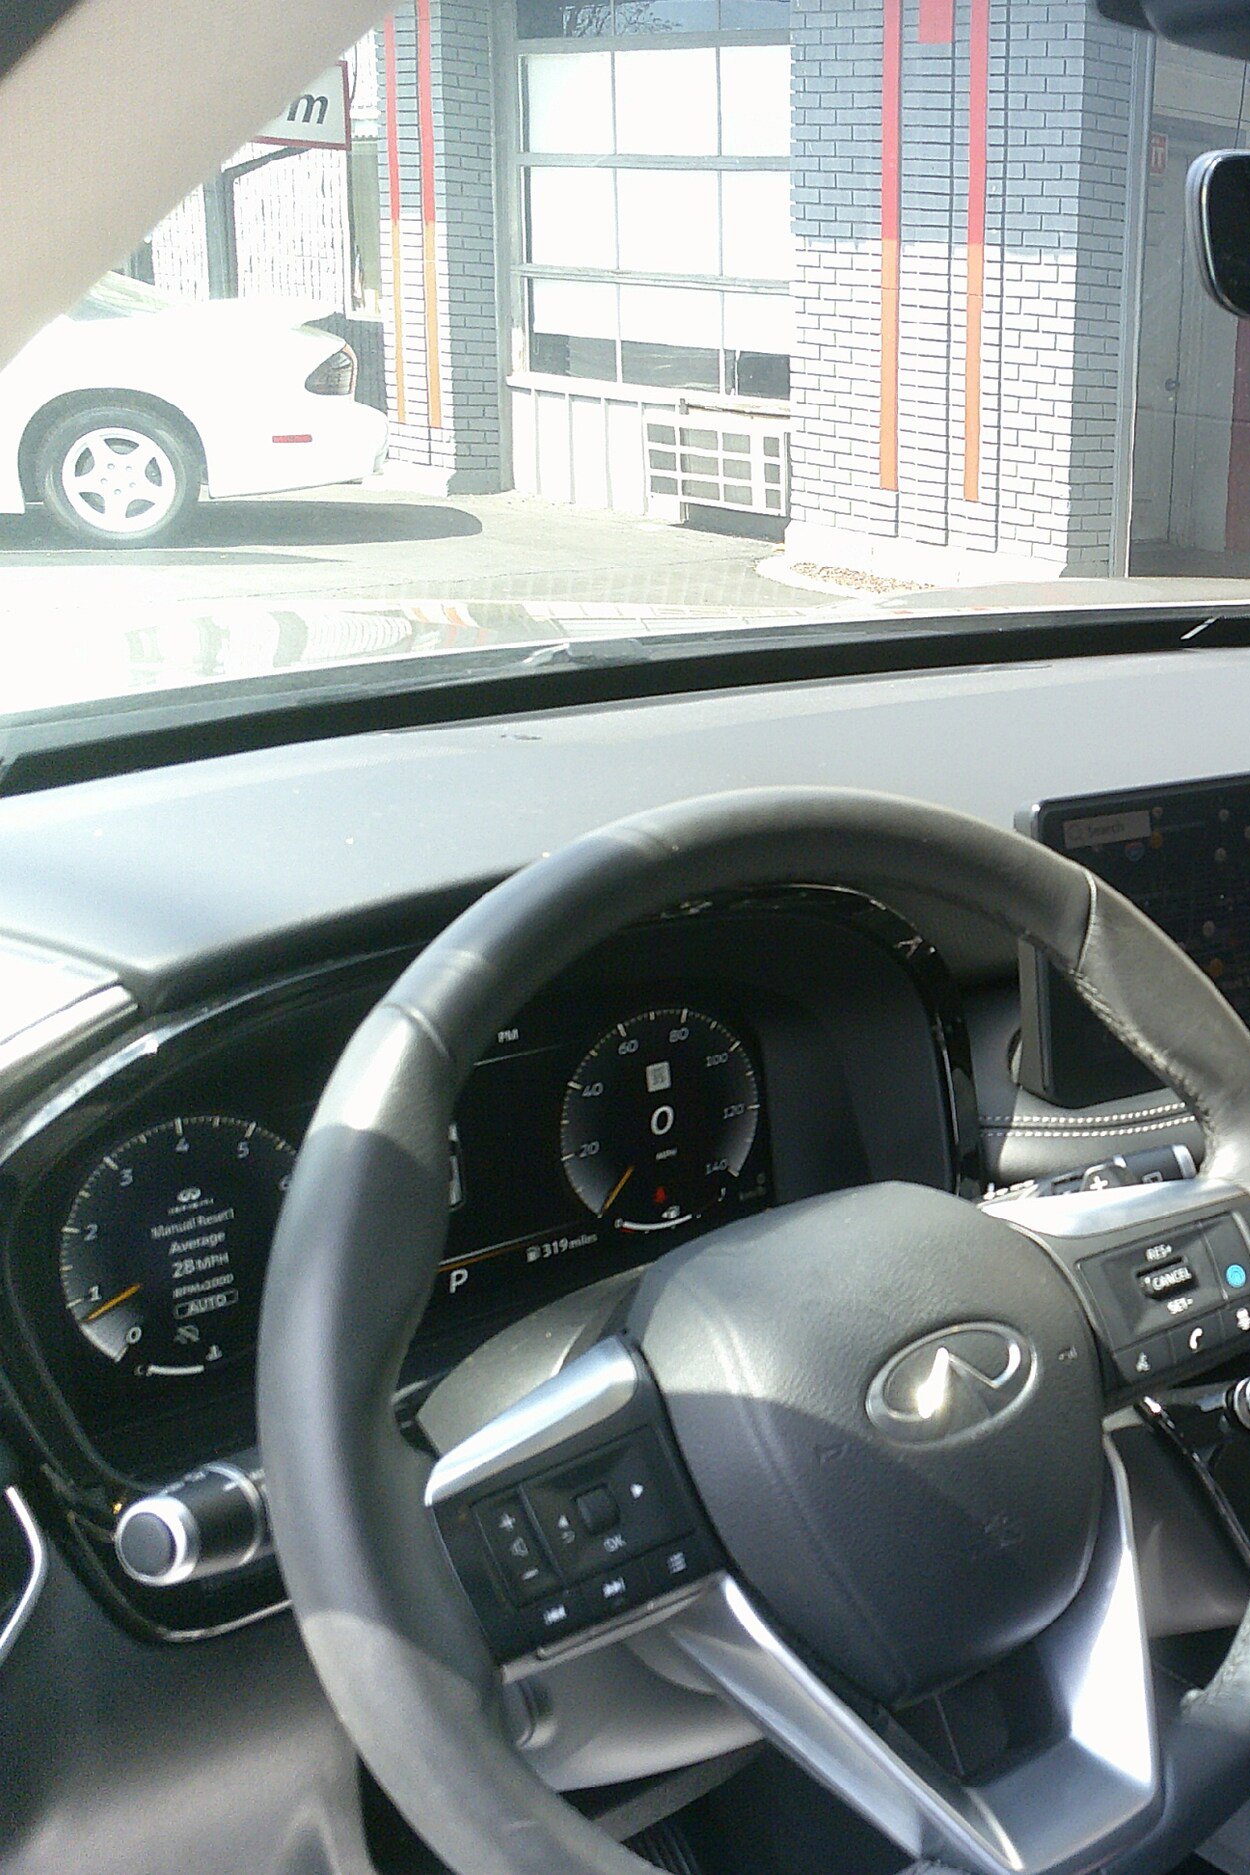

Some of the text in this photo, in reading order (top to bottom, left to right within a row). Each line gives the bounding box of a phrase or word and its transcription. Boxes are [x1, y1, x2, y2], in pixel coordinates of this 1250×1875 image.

[669, 1027, 689, 1043] 80
[618, 1039, 639, 1056] 60
[651, 1105, 674, 1135] 0
[175, 1137, 190, 1153] 4
[237, 1141, 250, 1158] 5
[580, 1141, 600, 1158] 20
[120, 1168, 133, 1187] 3
[84, 1224, 99, 1241] 2
[151, 1217, 196, 1239] Manual
[168, 1232, 226, 1255] Average
[541, 1233, 598, 1258] 319 miles
[172, 1252, 229, 1279] 28 MPH
[450, 1268, 468, 1293] P
[1152, 1267, 1192, 1291] CANCEL
[88, 1286, 101, 1301] 1
[188, 1293, 228, 1314] AUTO
[126, 1326, 142, 1344] 0
[603, 1534, 627, 1552] OK
